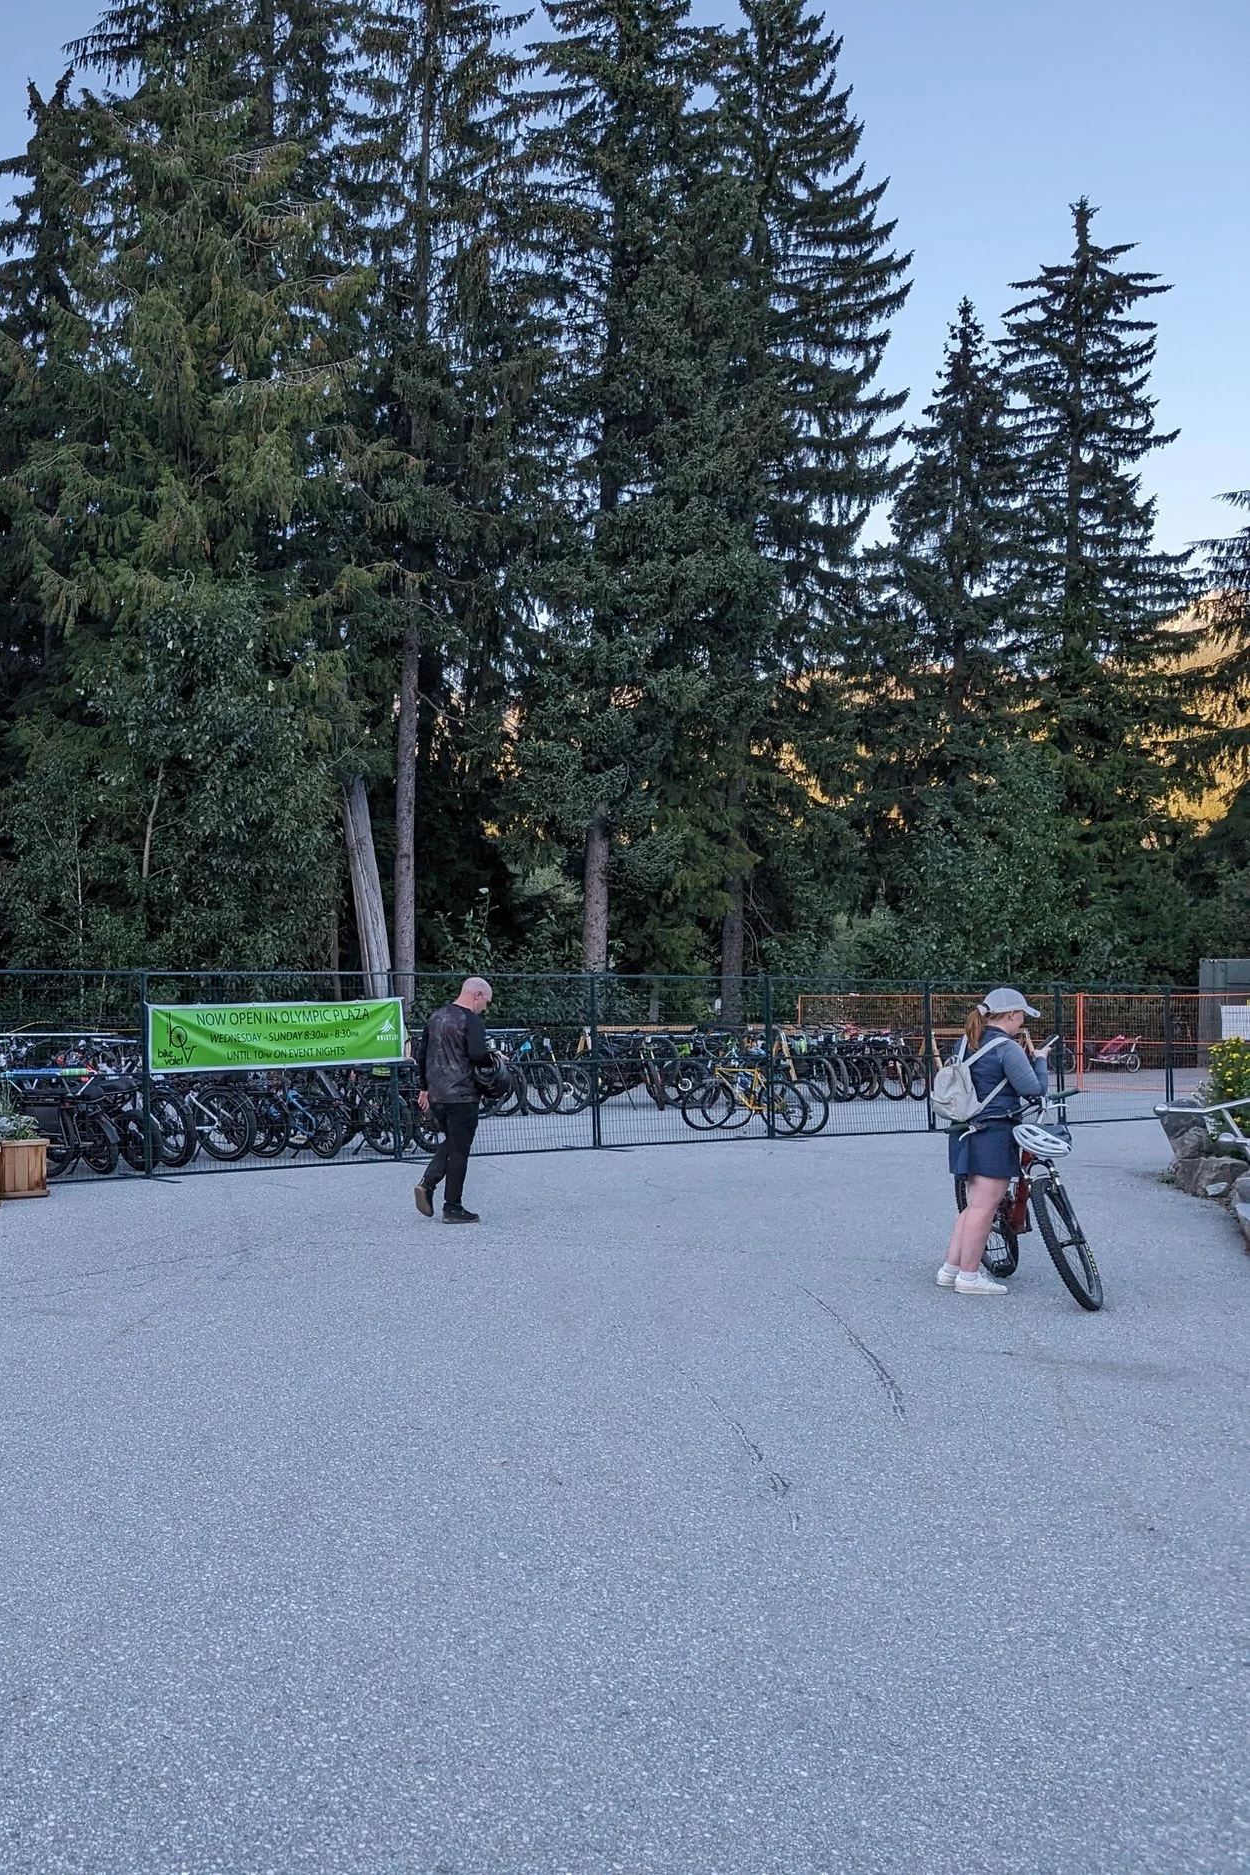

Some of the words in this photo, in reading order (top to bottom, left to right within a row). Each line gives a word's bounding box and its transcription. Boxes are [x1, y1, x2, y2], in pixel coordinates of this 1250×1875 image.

[196, 1012, 227, 1026] NOW
[229, 1011, 263, 1025] OPEN
[265, 1010, 278, 1024] IN
[280, 1009, 331, 1024] OLYMPIC
[333, 1008, 370, 1021] PLAZA
[210, 1033, 262, 1044] WEDNESDAY
[269, 1031, 303, 1042] SUNDAY
[157, 1048, 174, 1058] bike
[226, 1050, 252, 1061] UNTIL
[273, 1049, 287, 1059] ON
[289, 1047, 314, 1059] EVENT
[316, 1046, 346, 1057] NIGHTS
[164, 1055, 184, 1065] valet
